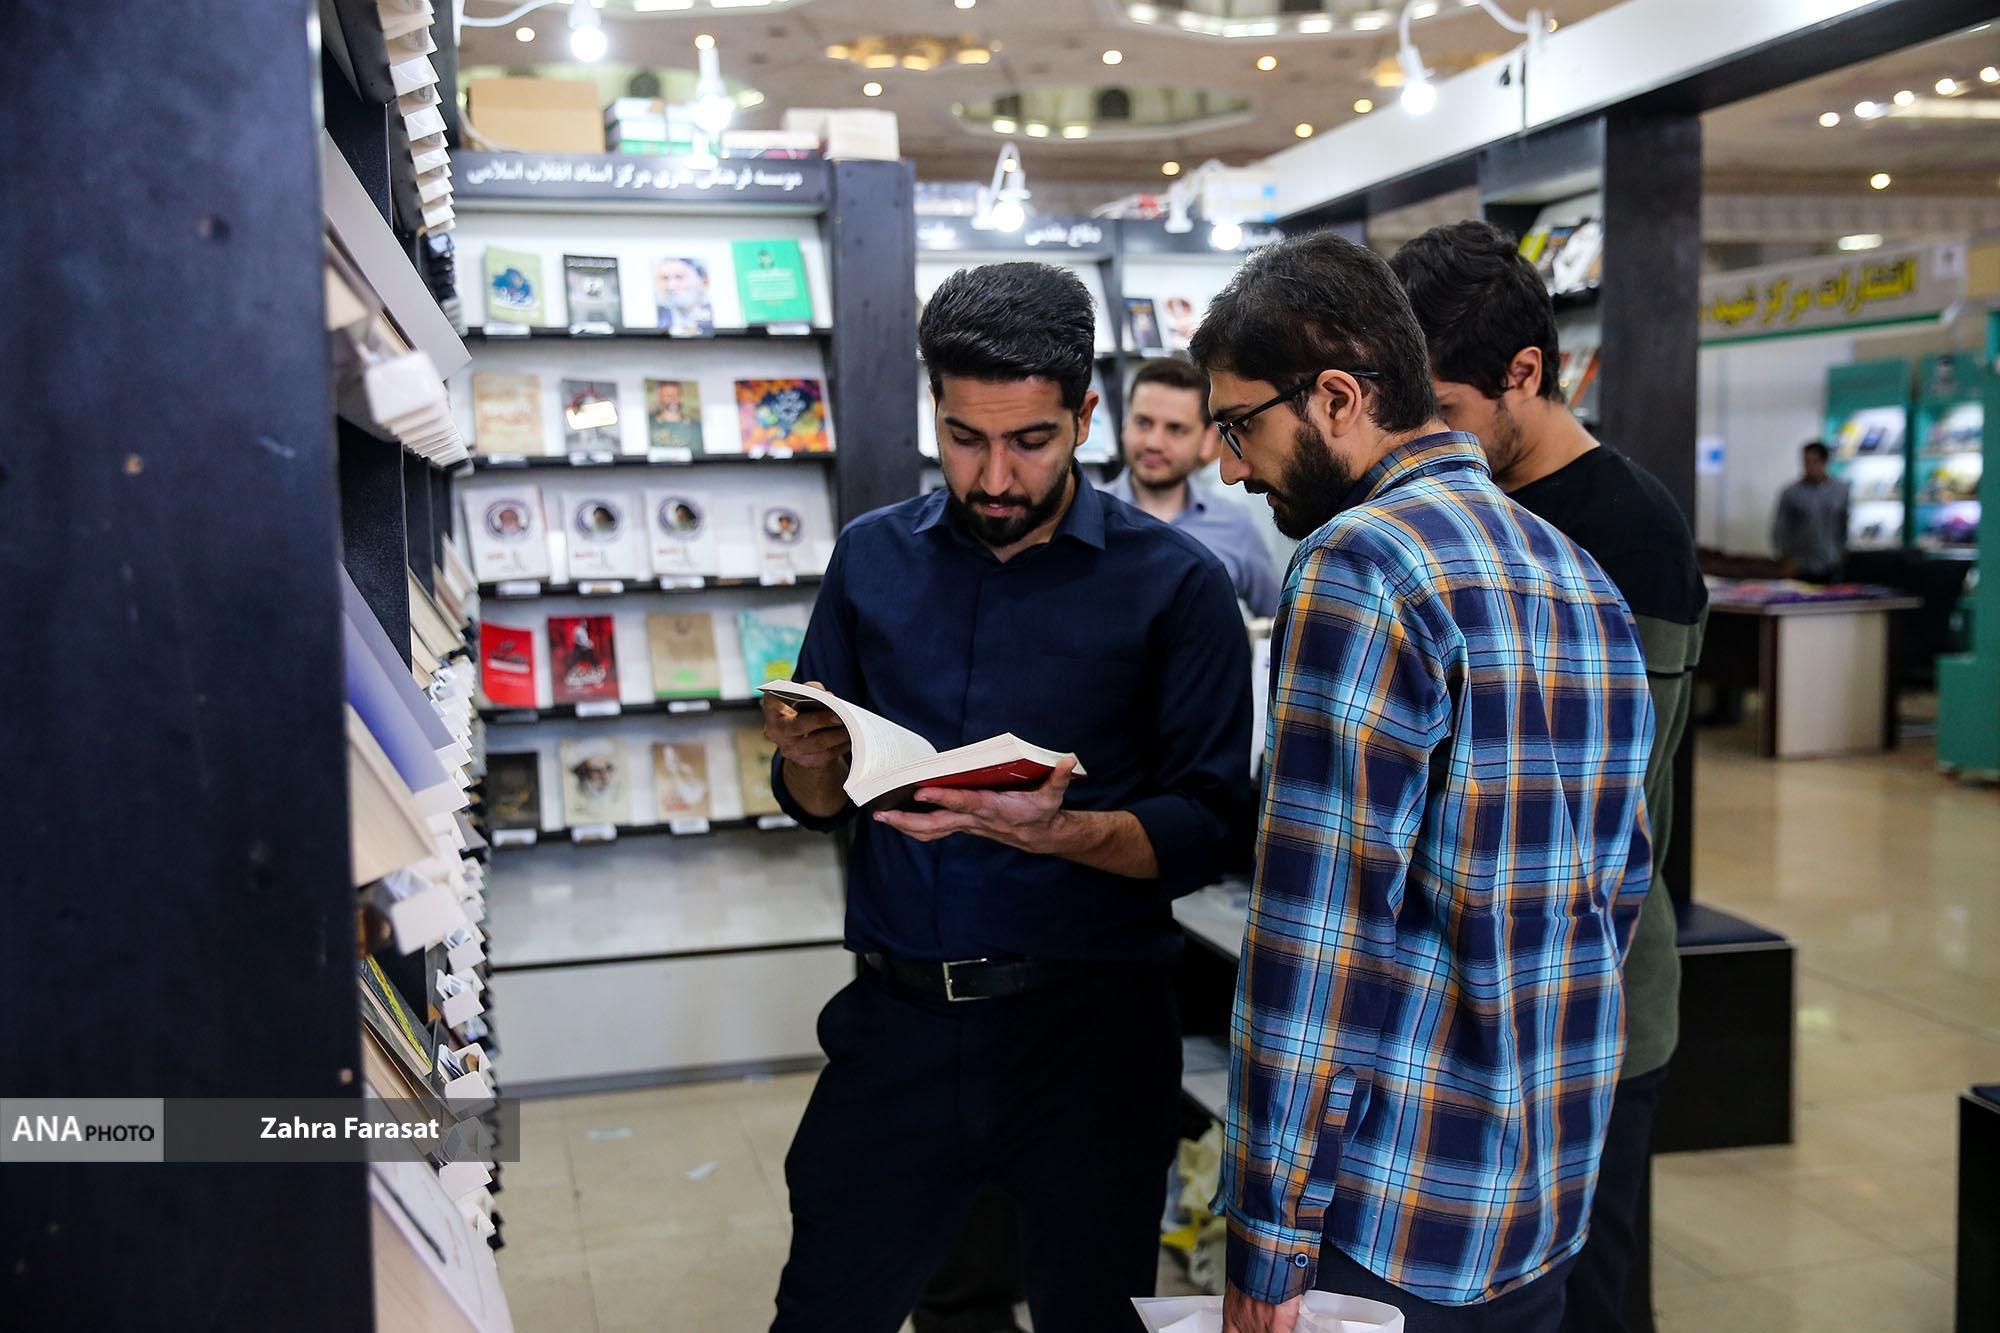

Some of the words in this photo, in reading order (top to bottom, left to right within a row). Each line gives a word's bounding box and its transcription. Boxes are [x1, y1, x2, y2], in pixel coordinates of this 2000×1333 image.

[466, 158, 524, 185] اسلامی
[524, 160, 573, 185] انقلاب
[574, 160, 613, 184] اسناد
[614, 162, 652, 190] مرکز
[1817, 256, 1918, 317] انتشارات
[1761, 276, 1813, 328] مرکز
